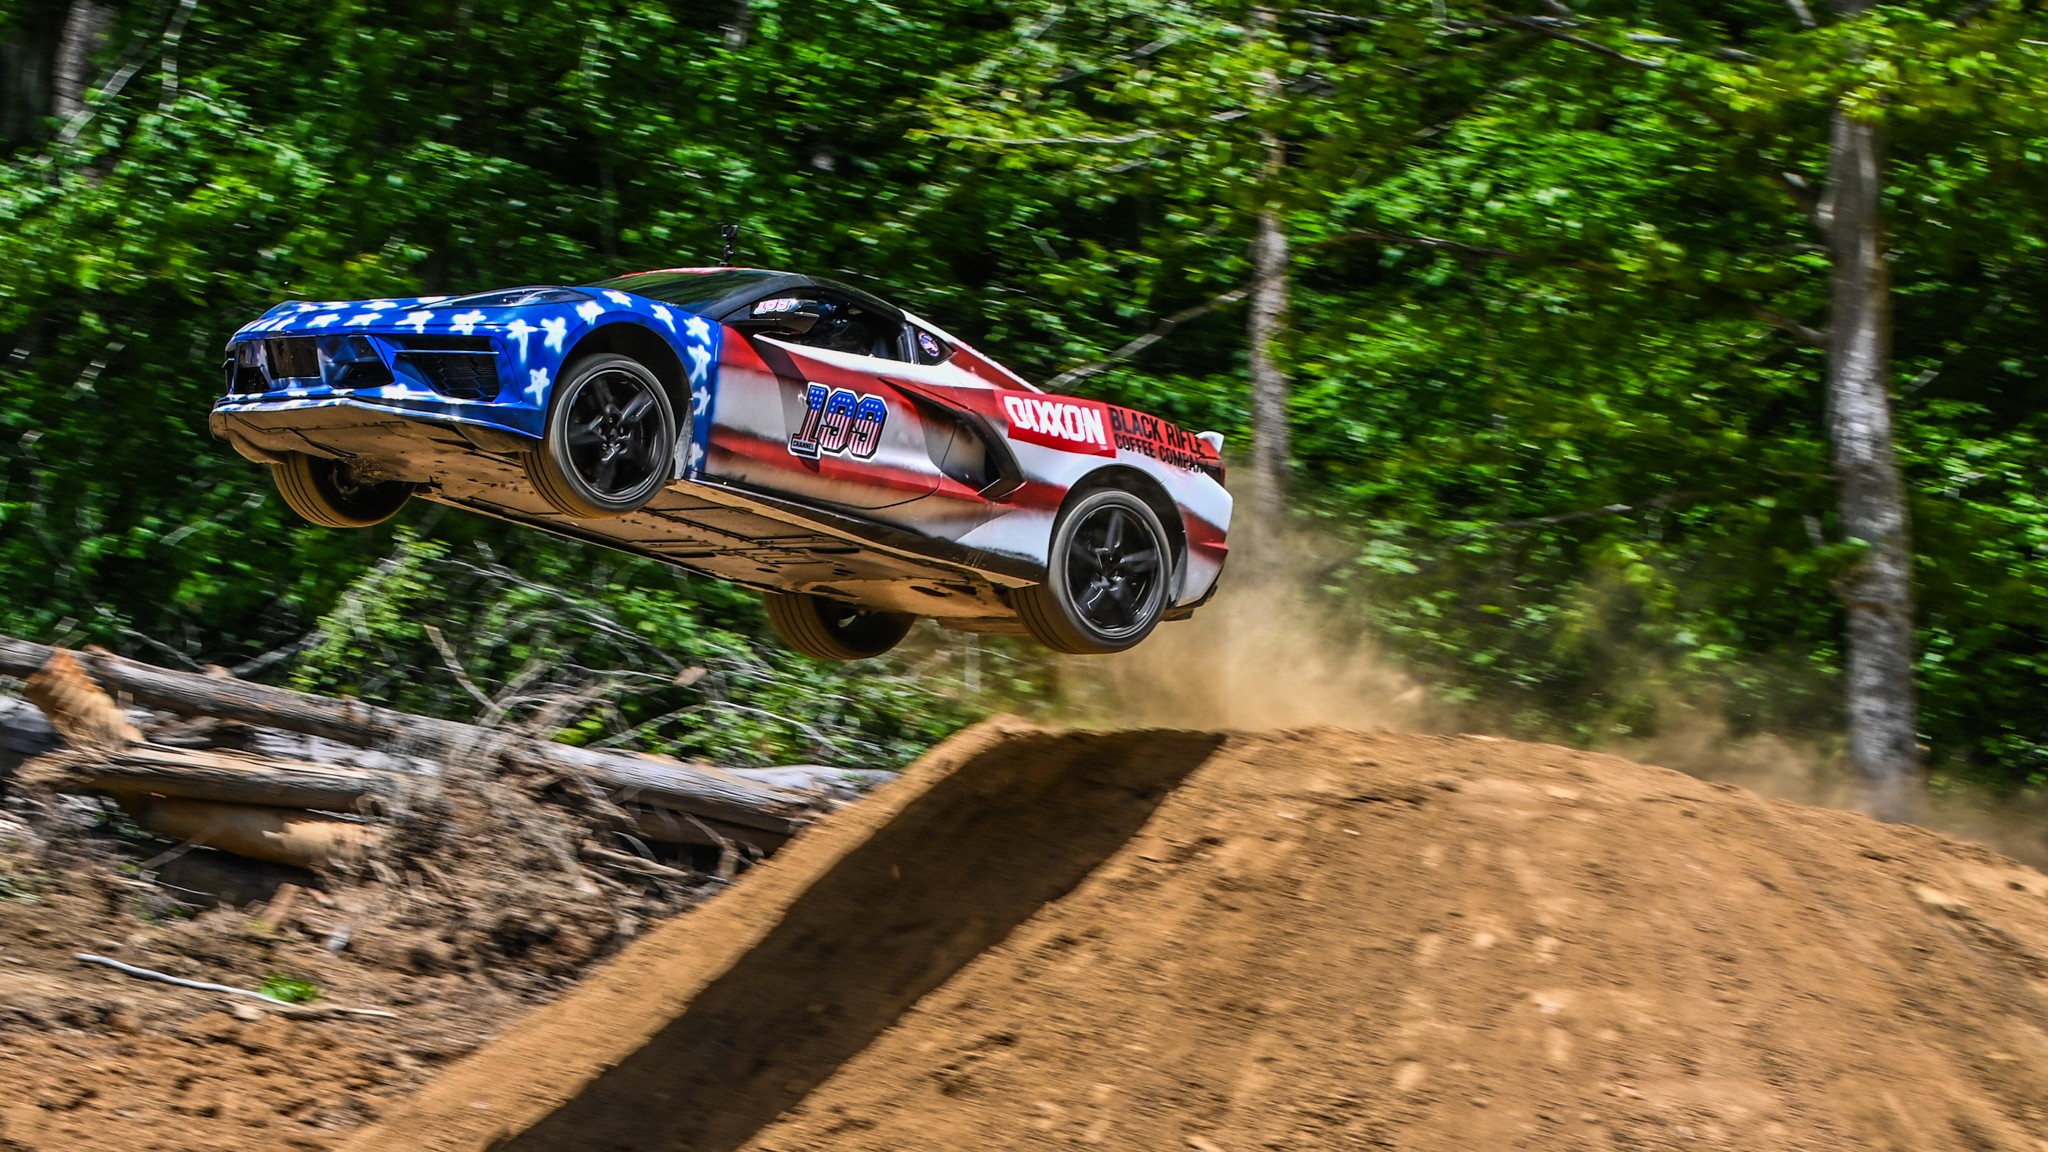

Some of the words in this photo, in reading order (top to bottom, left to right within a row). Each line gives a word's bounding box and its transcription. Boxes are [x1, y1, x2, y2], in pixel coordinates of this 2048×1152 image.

[1003, 395, 1107, 445] DIXXON
[1109, 407, 1163, 443] BLACK
[1164, 423, 1204, 455] RIFLE
[1113, 433, 1156, 458] COFFEE
